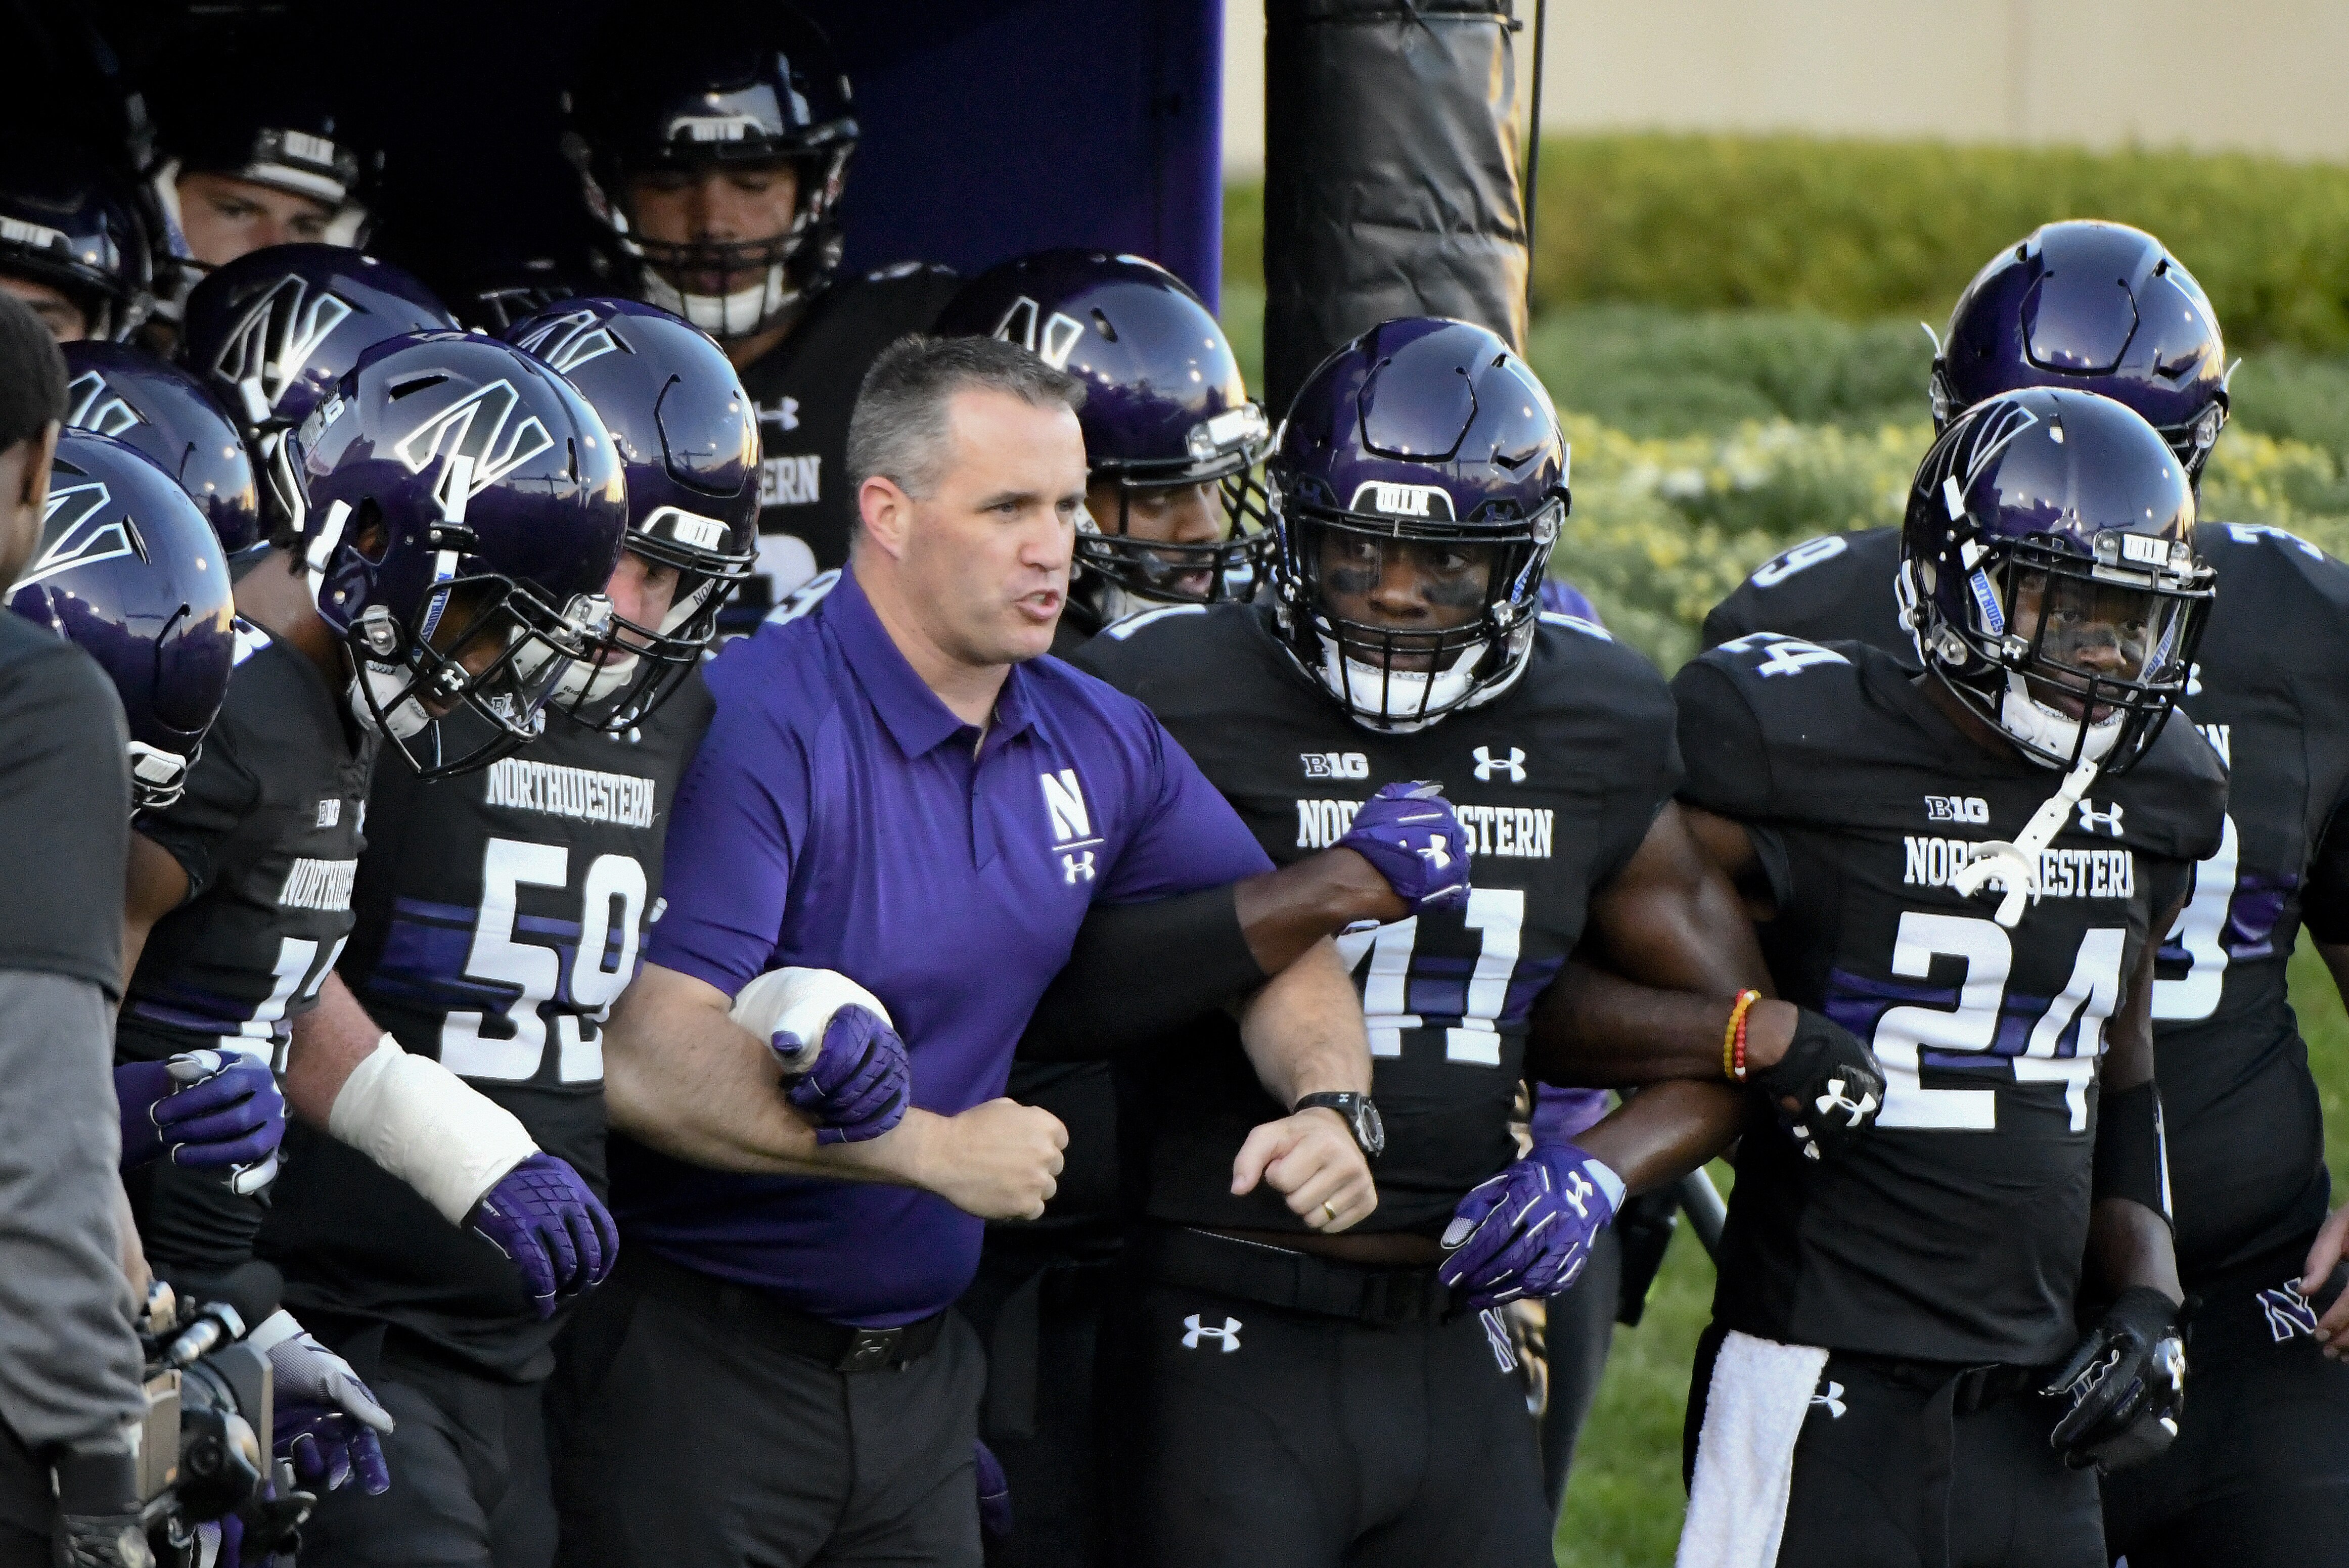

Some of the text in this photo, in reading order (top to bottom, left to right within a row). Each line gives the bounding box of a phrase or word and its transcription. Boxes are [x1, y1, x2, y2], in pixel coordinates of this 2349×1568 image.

[485, 757, 655, 828] NORTHWESTERN
[1041, 768, 1091, 840] N
[440, 837, 647, 1083] 59
[1875, 911, 2127, 1132] 24
